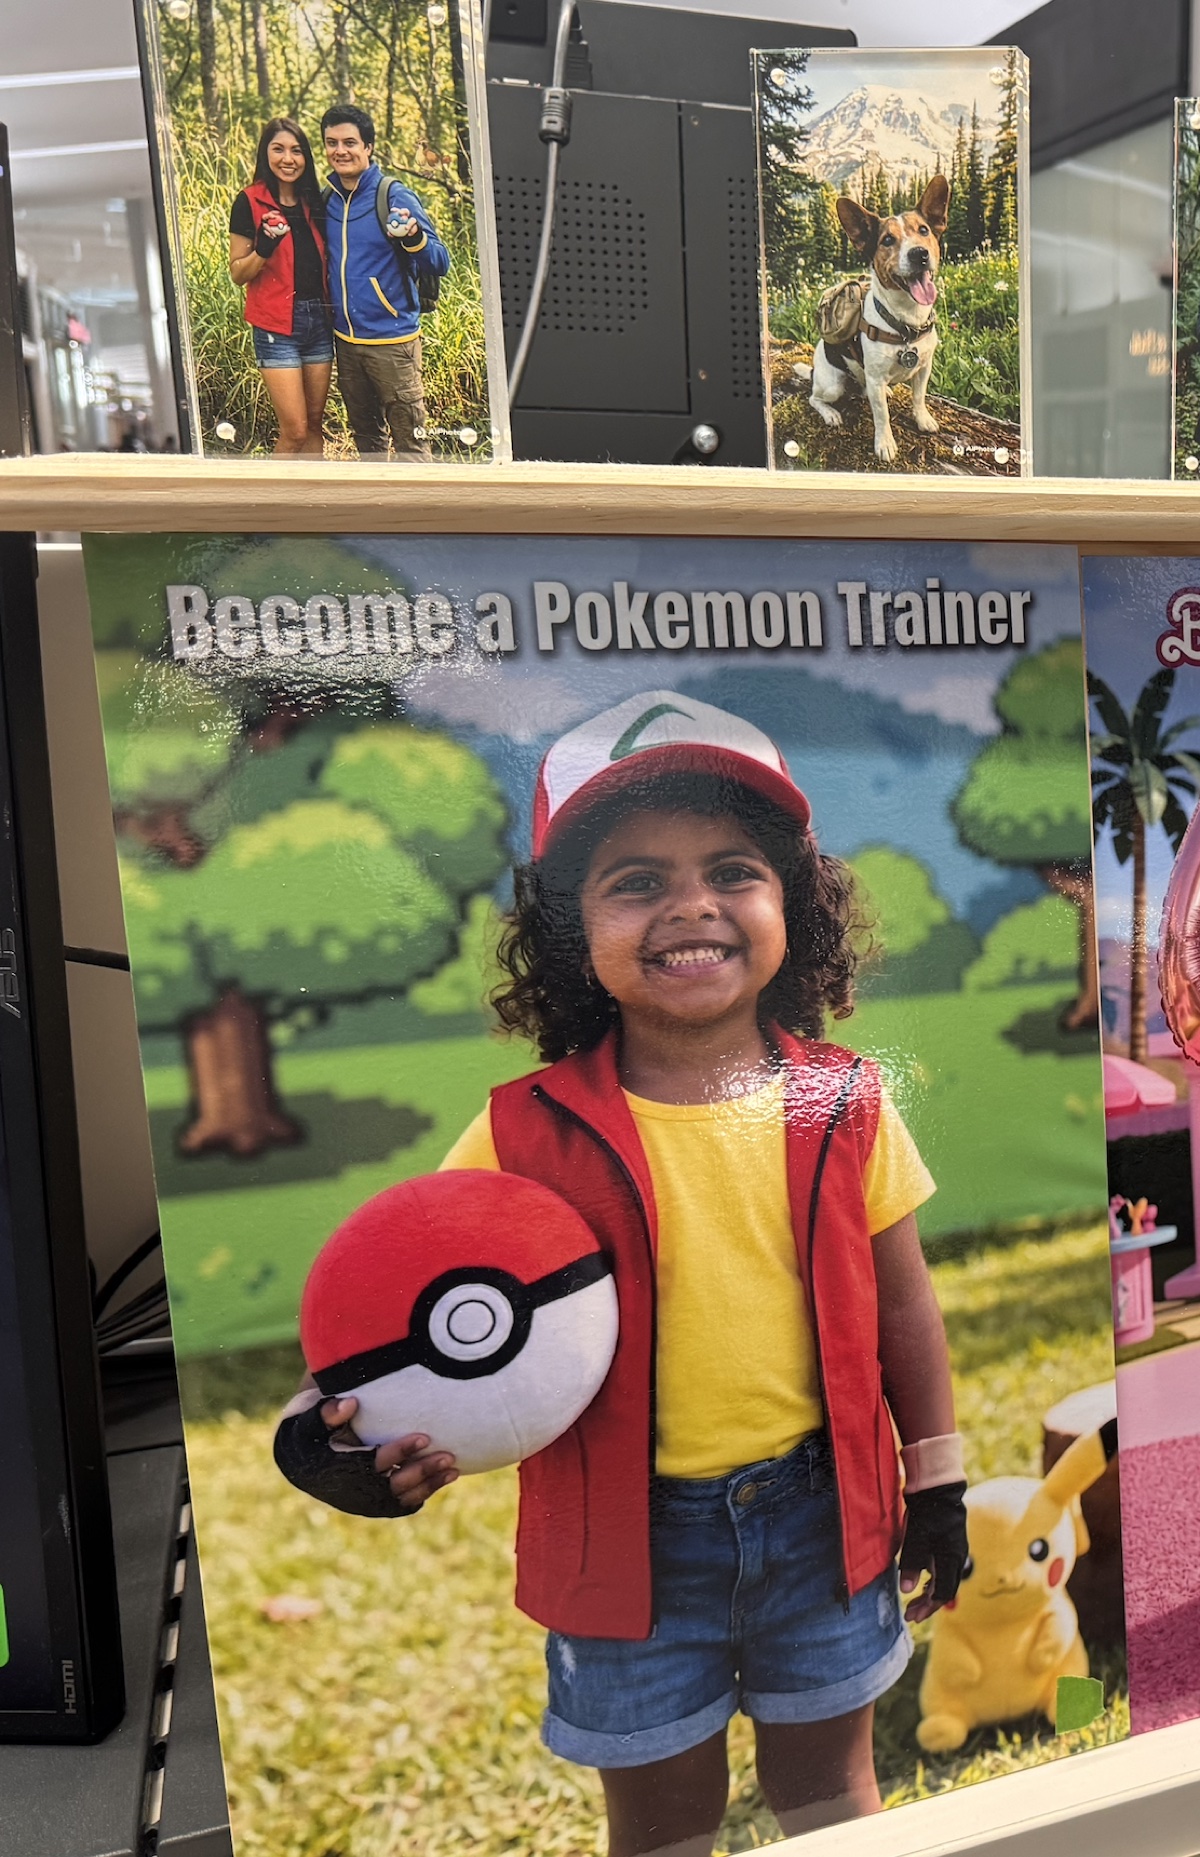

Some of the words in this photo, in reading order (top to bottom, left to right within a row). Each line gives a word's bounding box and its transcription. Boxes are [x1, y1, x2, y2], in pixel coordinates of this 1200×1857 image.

[165, 584, 457, 661] Become
[475, 592, 515, 652] a
[533, 581, 823, 651] Pokemon
[837, 577, 1031, 647] Trainer
[62, 1660, 77, 1714] HDMI
